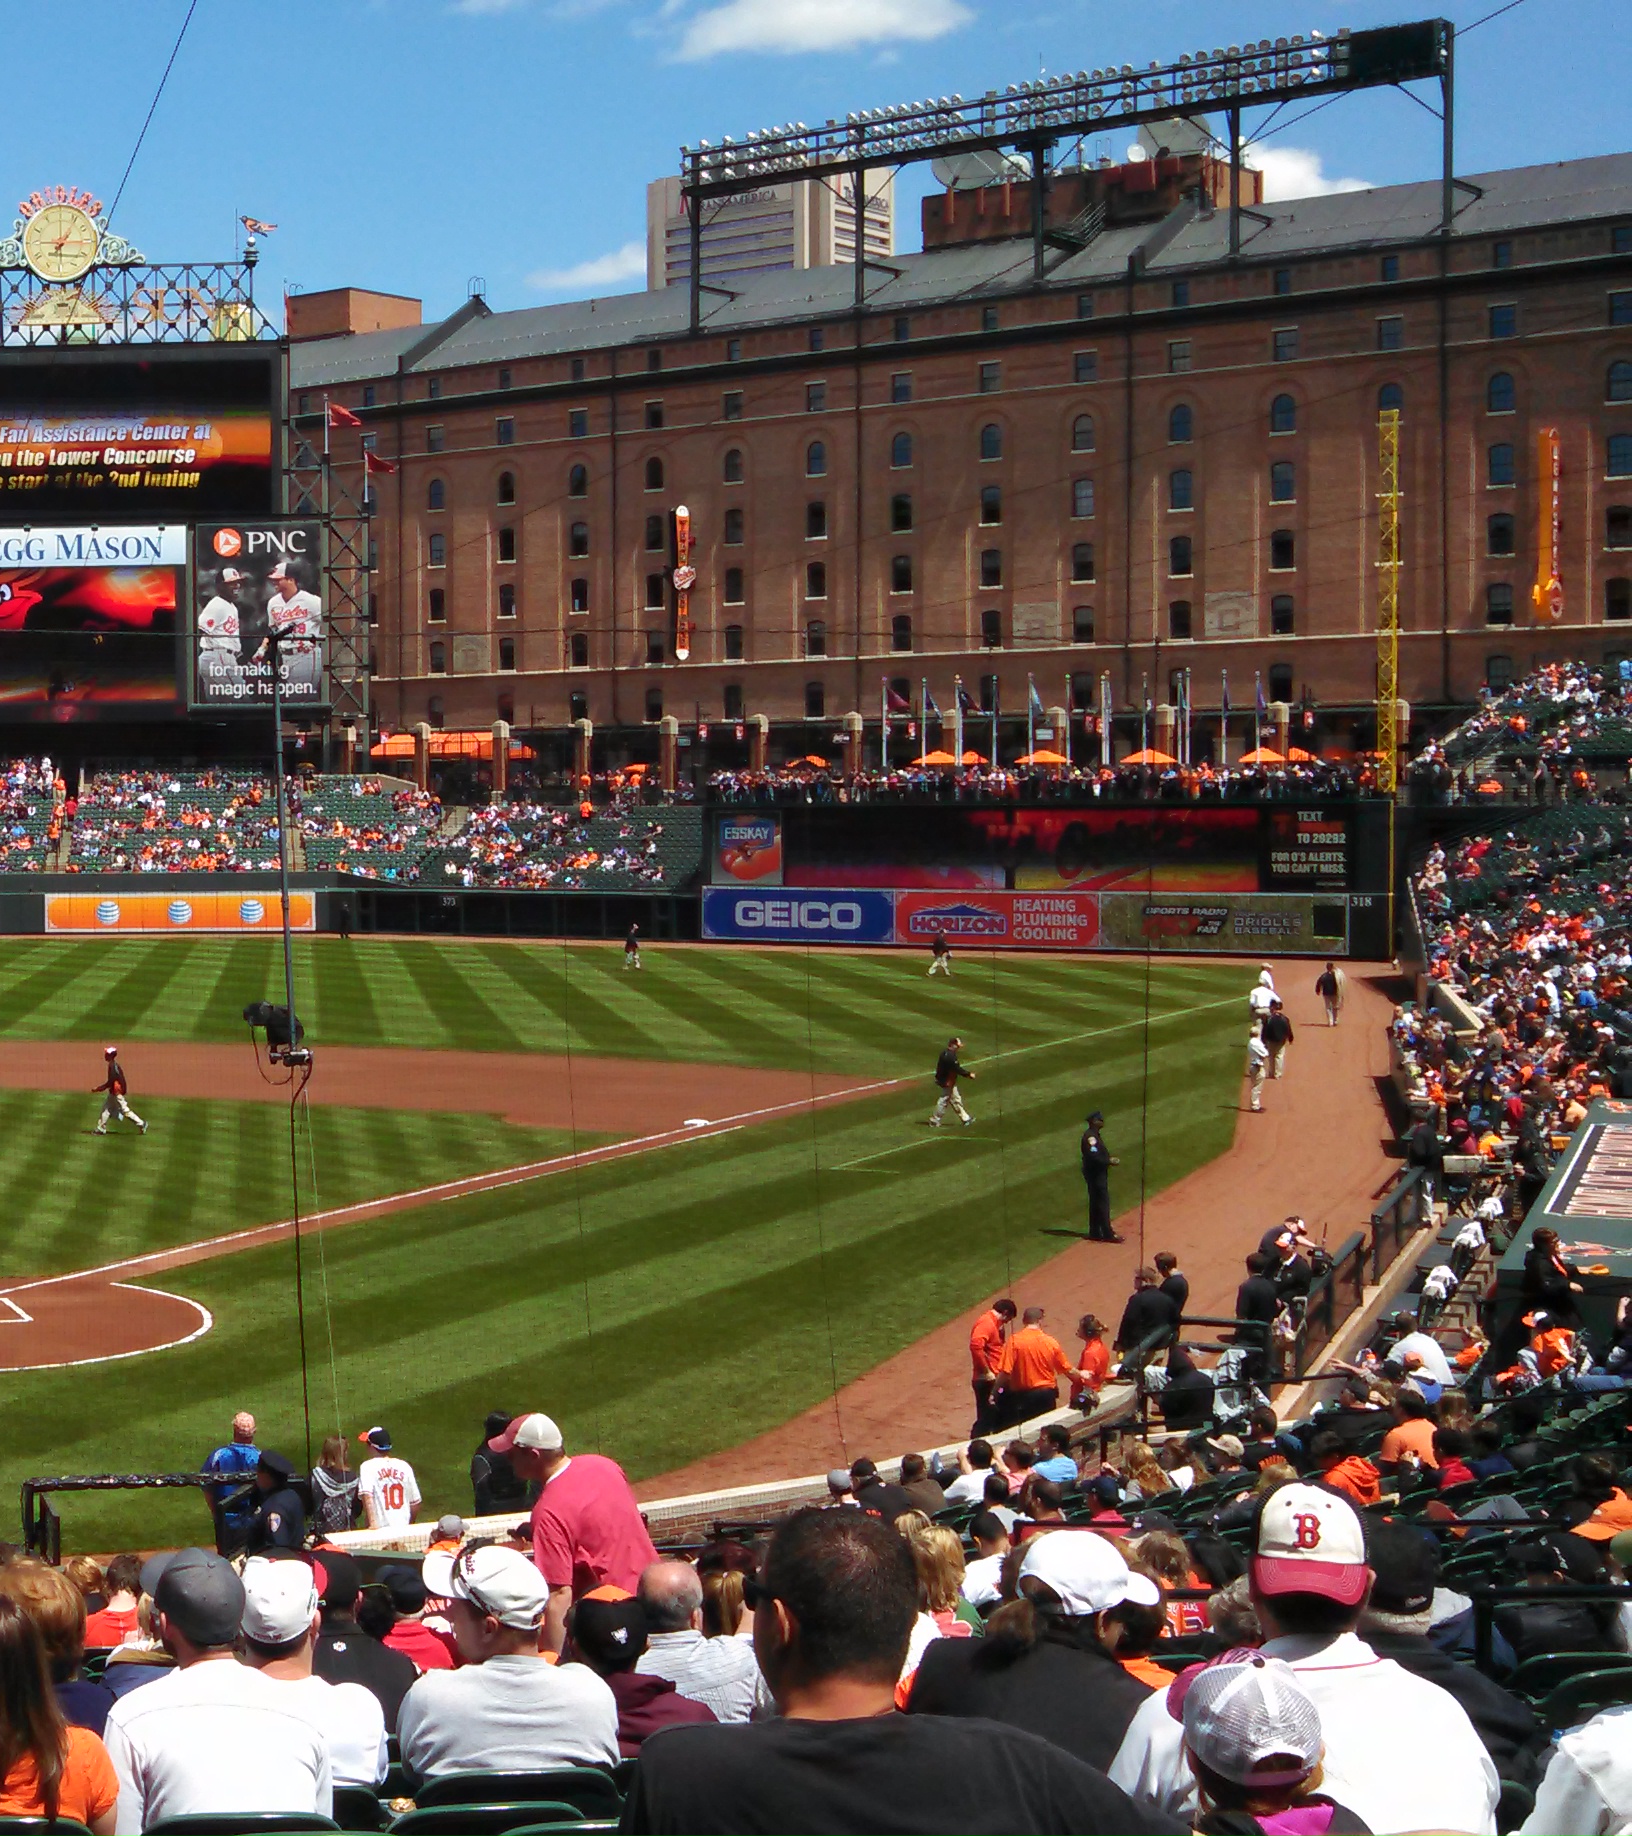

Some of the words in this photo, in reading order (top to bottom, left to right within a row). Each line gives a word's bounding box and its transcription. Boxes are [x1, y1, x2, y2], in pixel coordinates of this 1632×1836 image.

[132, 287, 218, 324] SUN
[0, 427, 28, 443] Fan
[32, 425, 127, 443] Assistance
[131, 424, 190, 441] Center
[193, 424, 211, 440] at
[17, 450, 45, 466] the
[49, 449, 98, 465] Lower
[103, 448, 196, 465] Concourse
[7, 472, 50, 490] start
[76, 472, 103, 487] the
[109, 471, 139, 488] 2nd
[55, 533, 162, 560] MASON
[245, 530, 307, 553] PNC
[209, 661, 231, 676] for
[234, 661, 290, 679] makig
[209, 681, 254, 698] magic
[1297, 811, 1323, 821] TEXT
[724, 826, 769, 840] ESSKAY
[1297, 833, 1310, 844] TO
[1271, 852, 1289, 862] FOR
[1271, 863, 1290, 874] YOU
[1291, 863, 1318, 874] CAN'T
[441, 897, 456, 907] 373
[1013, 899, 1076, 912] HEATING
[1351, 897, 1372, 907] 318
[735, 900, 862, 930] GEICO
[1145, 907, 1189, 915] SPORTS
[1192, 908, 1228, 916] RADIO
[911, 916, 1005, 933] HORIZON
[1013, 913, 1088, 927] PLUMBING
[1234, 918, 1302, 927] ORIOLES
[1013, 927, 1078, 940] COOLING
[1197, 926, 1218, 934] FAN
[1235, 927, 1300, 935] BASEBALL
[377, 1466, 405, 1482] JONES
[382, 1483, 404, 1511] 10
[1292, 1513, 1321, 1549] B
